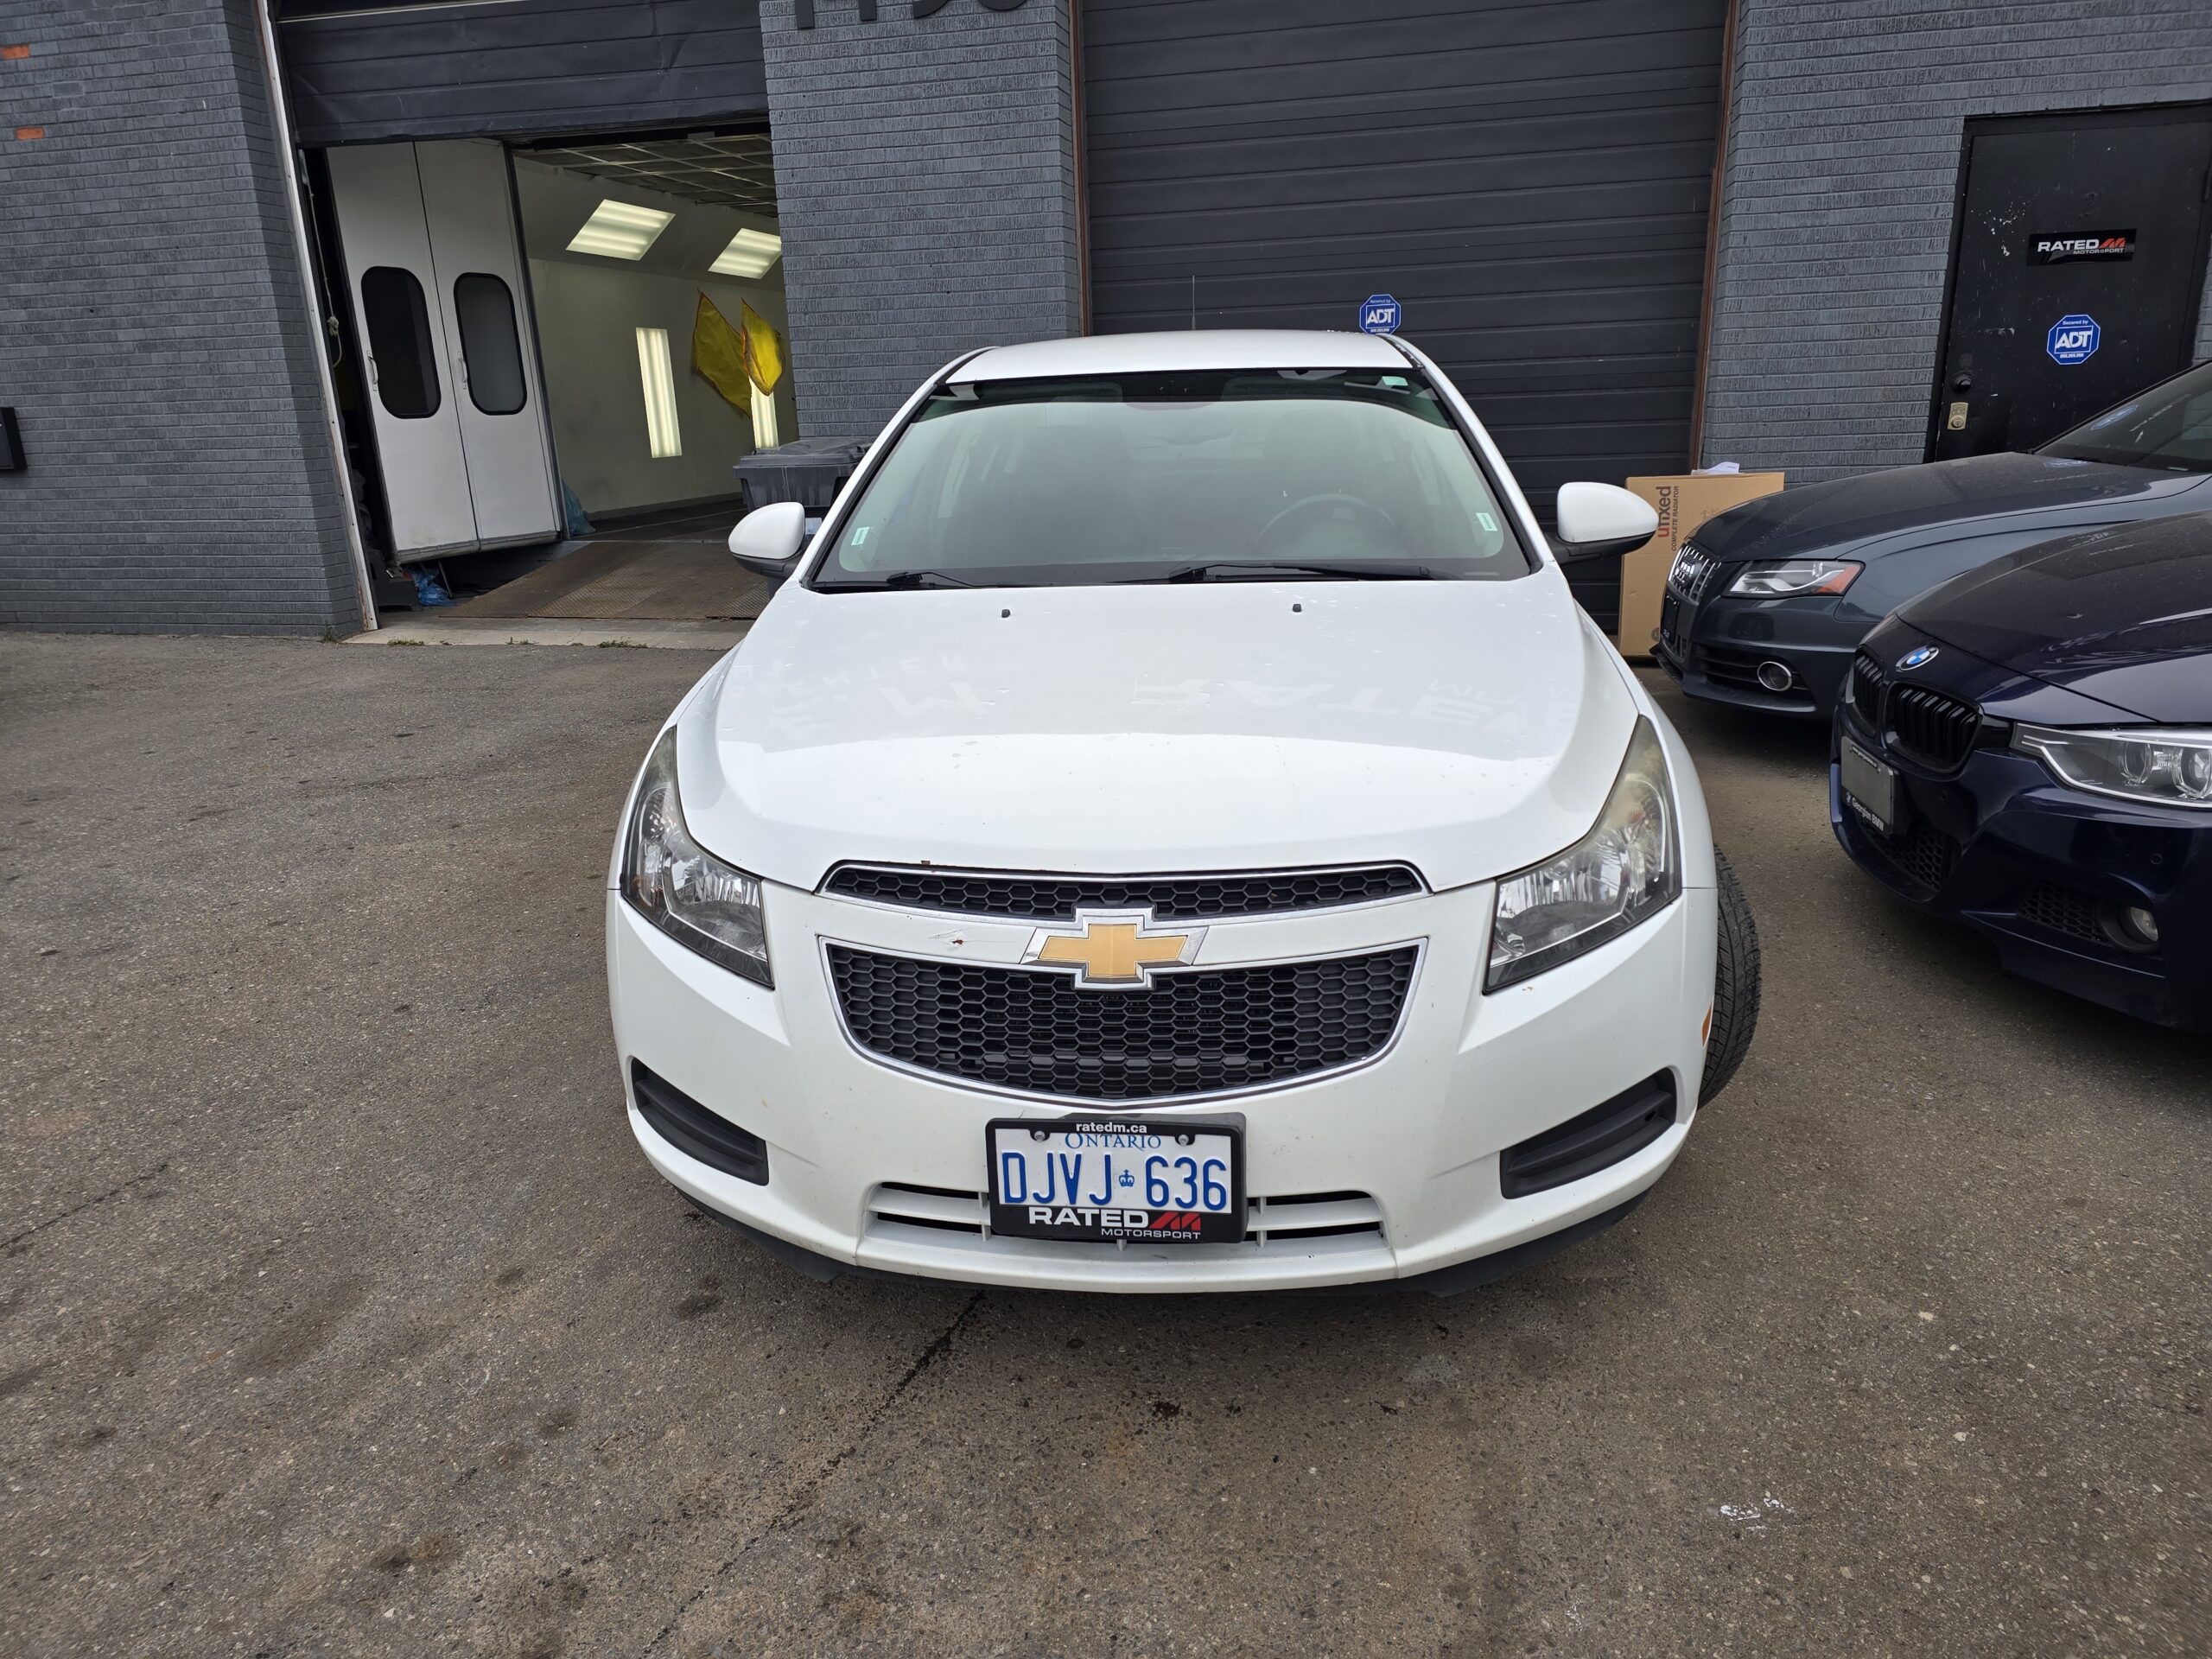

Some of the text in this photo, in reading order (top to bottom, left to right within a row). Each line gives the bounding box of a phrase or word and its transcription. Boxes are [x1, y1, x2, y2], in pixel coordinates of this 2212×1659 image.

[2037, 239, 2100, 252] RATED
[1367, 308, 1395, 324] ADT
[2056, 331, 2091, 349] ADT
[1076, 1122, 1147, 1134] ratedm.ca
[1065, 1132, 1161, 1152] ONTARIO
[1001, 1152, 1227, 1211] DJVJ 636
[1028, 1206, 1149, 1229] RATED
[1101, 1228, 1201, 1240] MOTORSPORT
